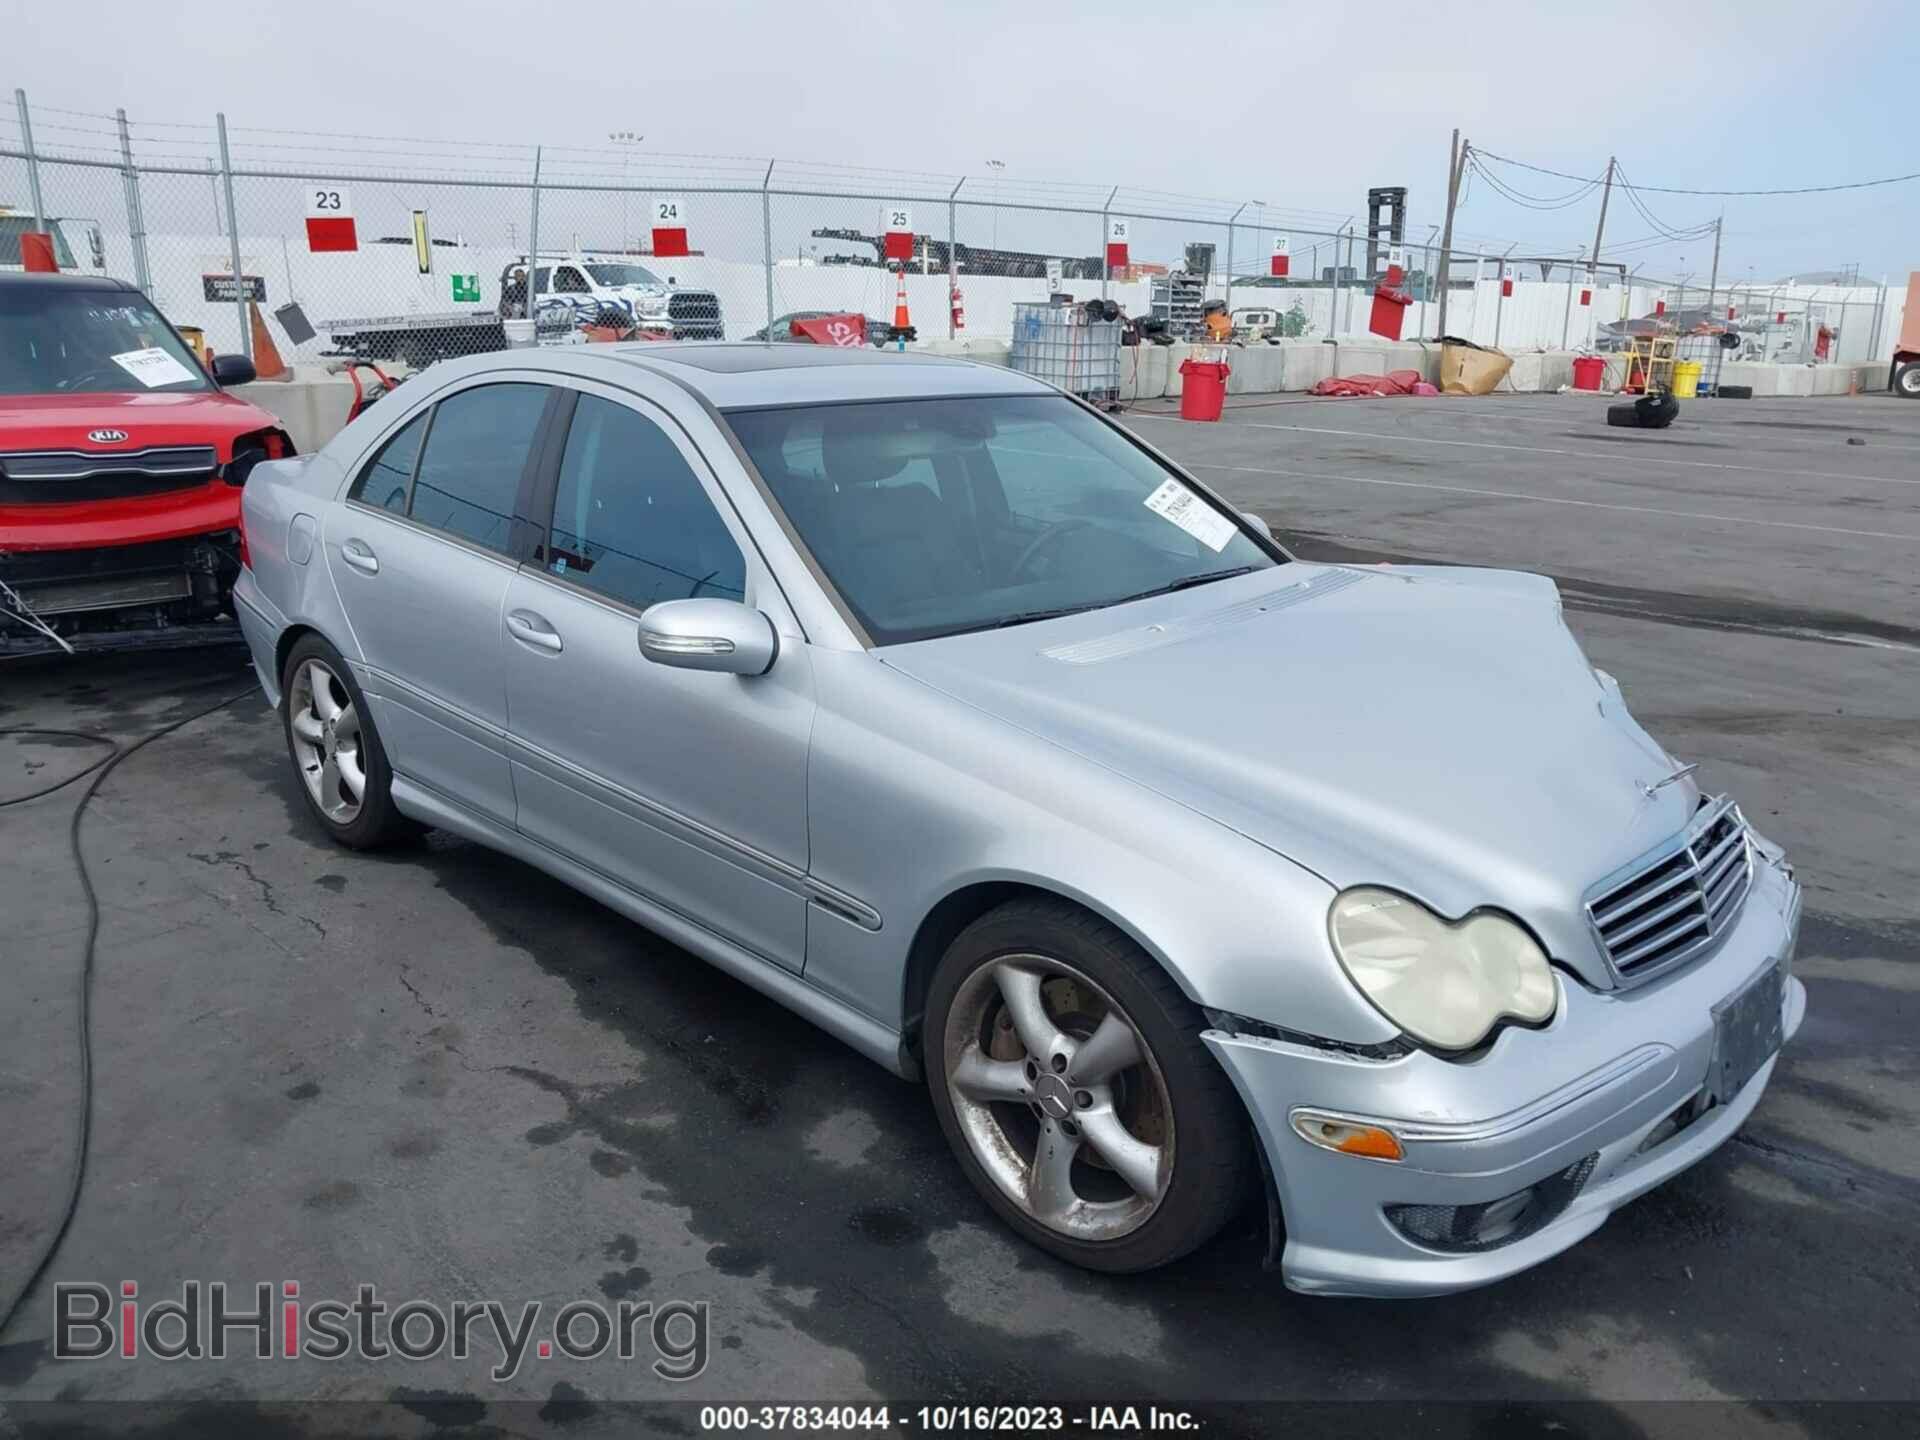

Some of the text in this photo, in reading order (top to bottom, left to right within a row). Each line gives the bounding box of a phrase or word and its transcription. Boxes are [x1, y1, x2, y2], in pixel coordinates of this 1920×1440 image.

[316, 191, 341, 210] 23
[659, 203, 677, 219] 24
[892, 211, 907, 226] 25
[1113, 223, 1126, 236] 26
[1051, 278, 1058, 289] 5
[94, 430, 123, 441] KIA
